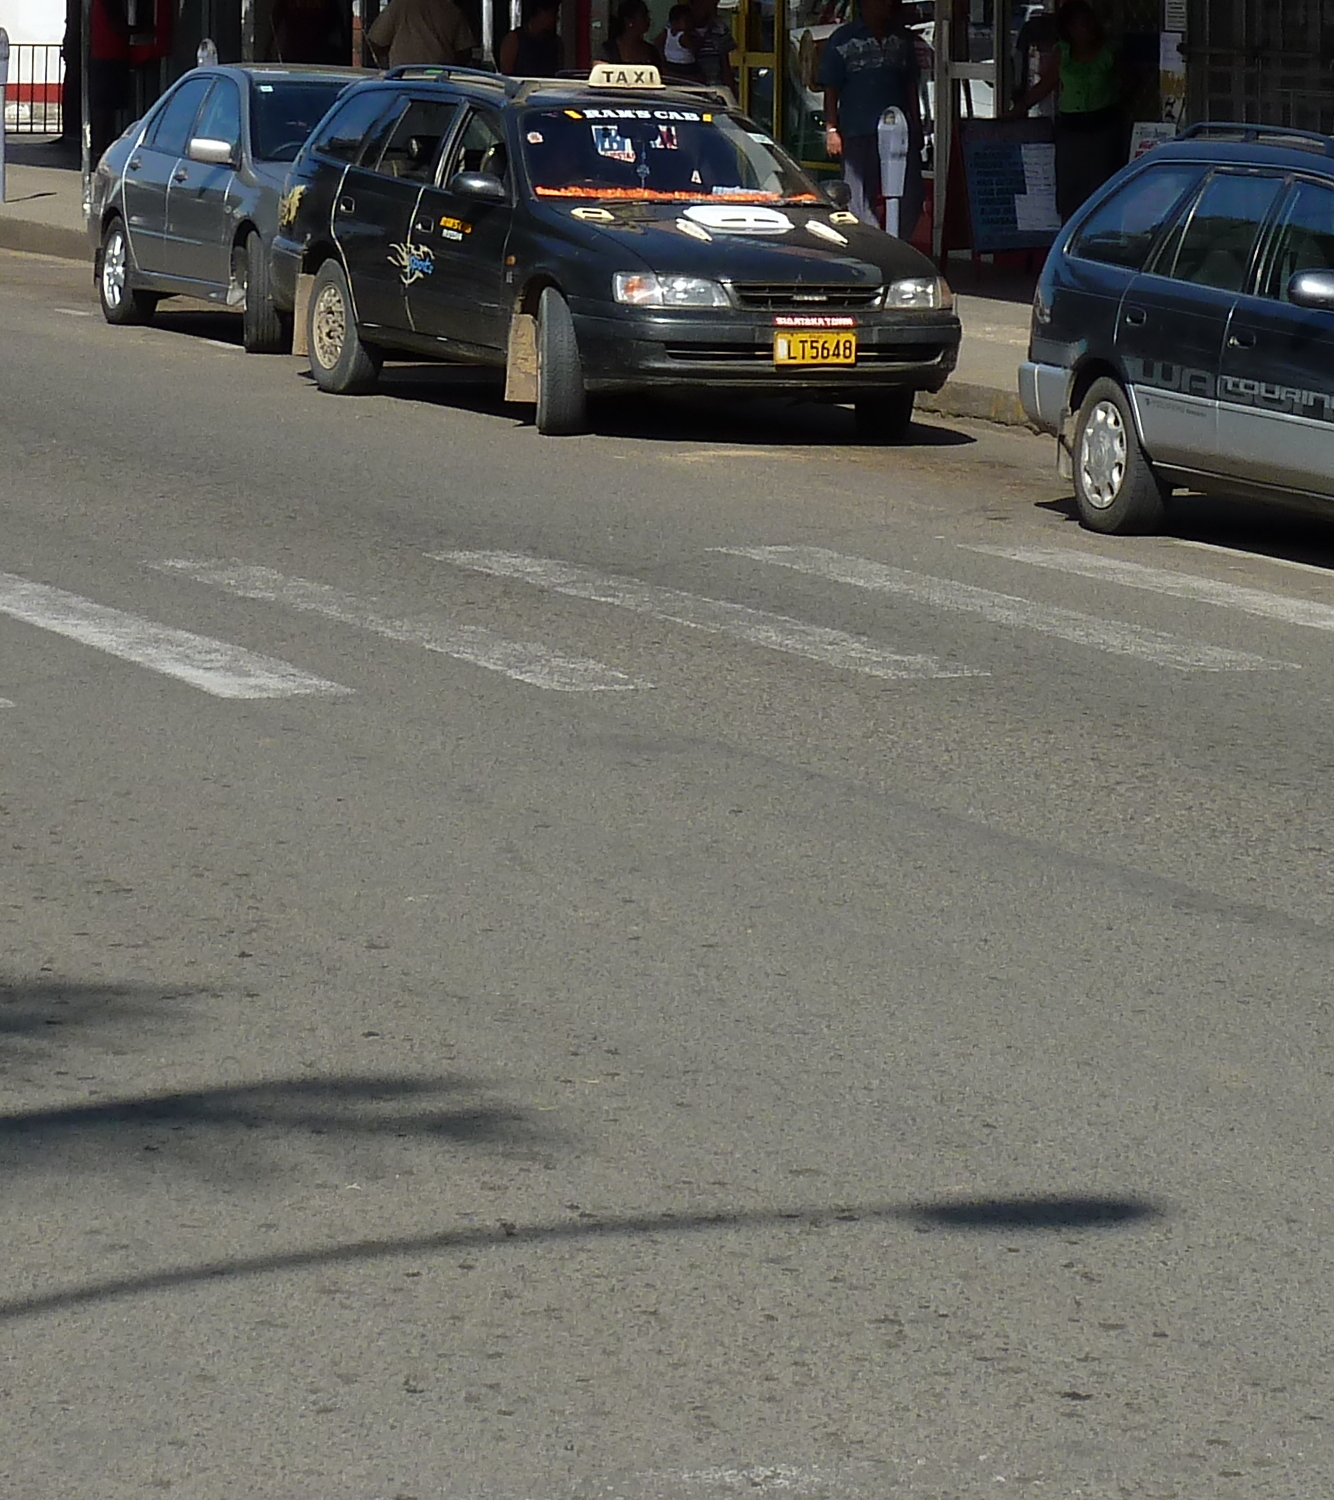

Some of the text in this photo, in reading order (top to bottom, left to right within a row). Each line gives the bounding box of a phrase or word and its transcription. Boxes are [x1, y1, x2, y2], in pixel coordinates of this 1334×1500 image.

[601, 71, 654, 84] TAXI
[582, 109, 701, 122] RAM'S CAB
[787, 339, 853, 360] LT5648
